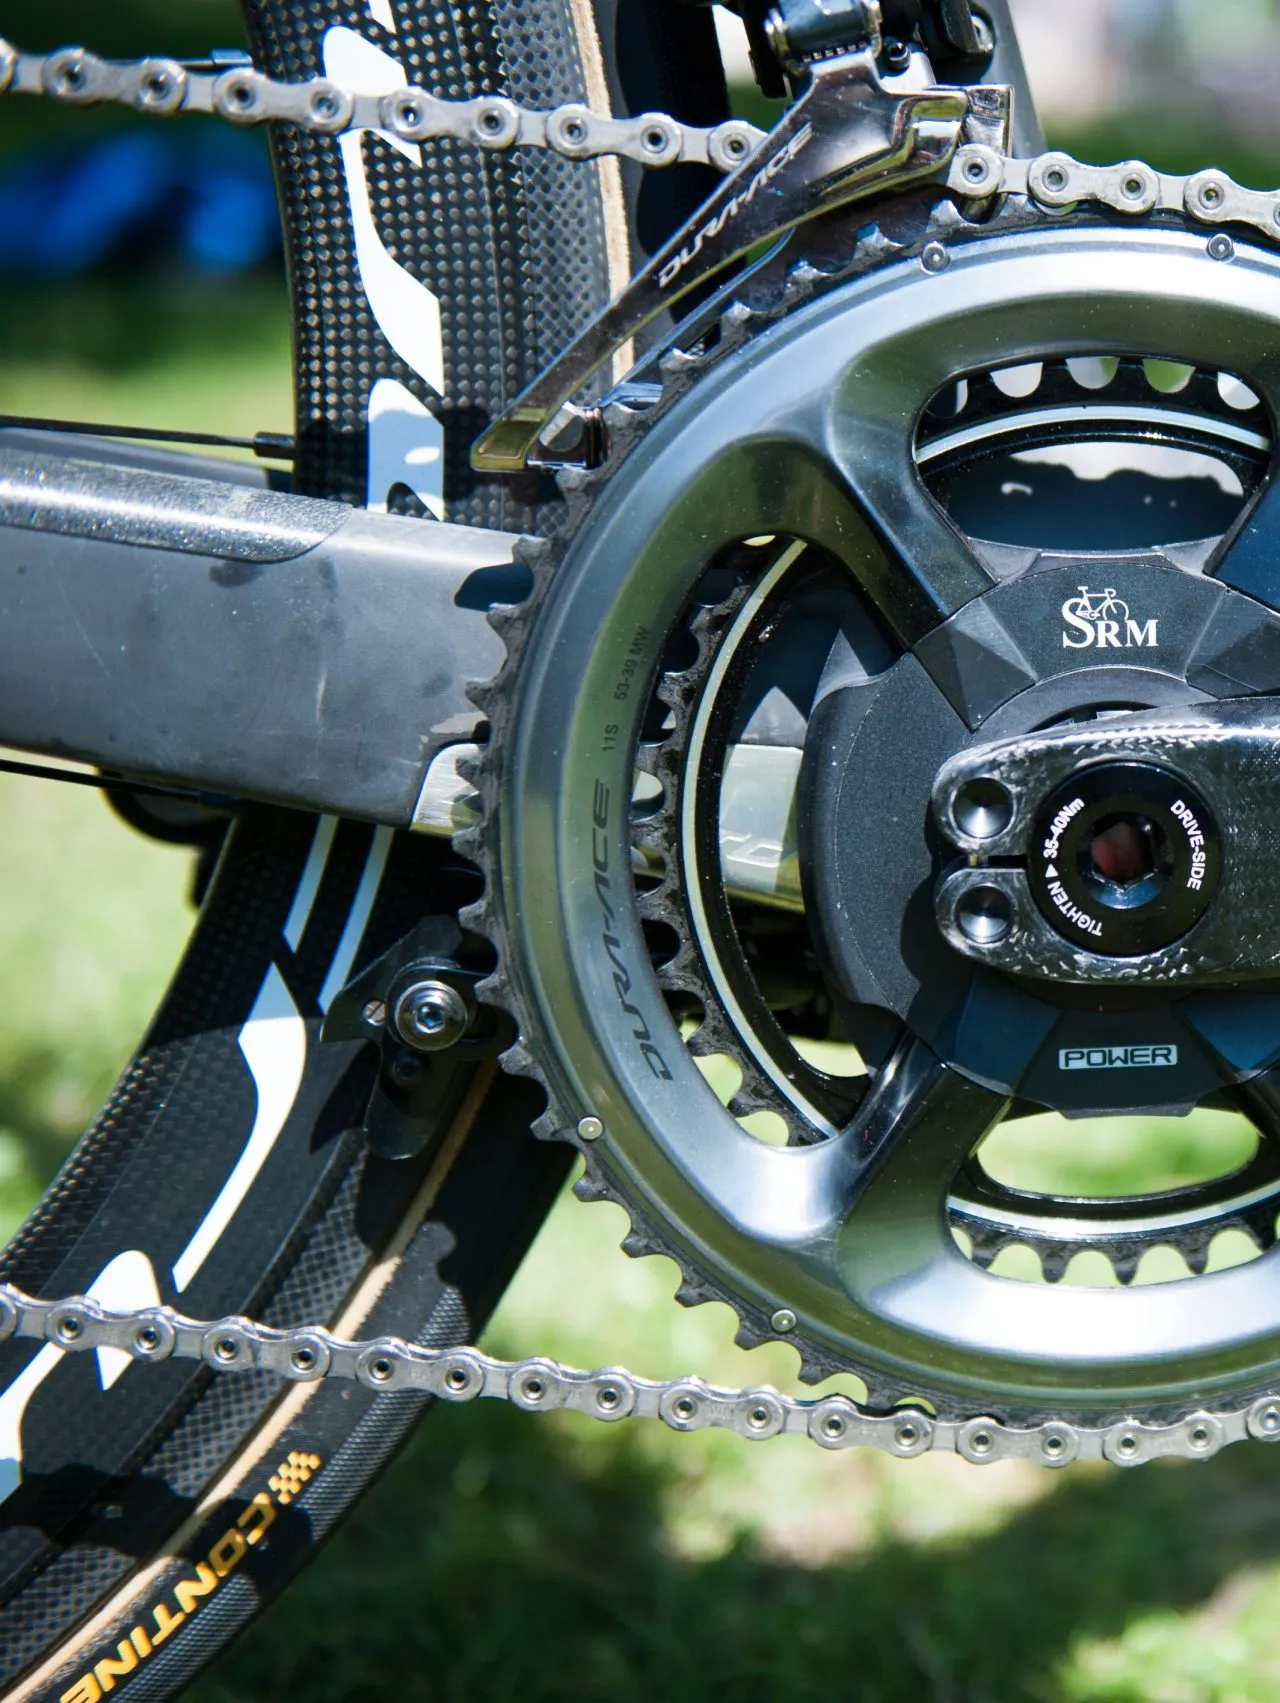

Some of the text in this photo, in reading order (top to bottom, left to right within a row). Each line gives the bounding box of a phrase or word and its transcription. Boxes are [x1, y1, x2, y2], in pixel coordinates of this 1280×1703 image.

[658, 122, 813, 288] DURA-ACE
[1061, 597, 1159, 649] SRM
[602, 723, 619, 752] 11S
[613, 659, 638, 700] 53-39
[1041, 798, 1104, 938] TIGHTEN 35-40Nm
[1170, 799, 1208, 892] DRIVE-SIDE
[592, 777, 674, 1082] DURA-ACE
[1064, 1046, 1173, 1069] POWER
